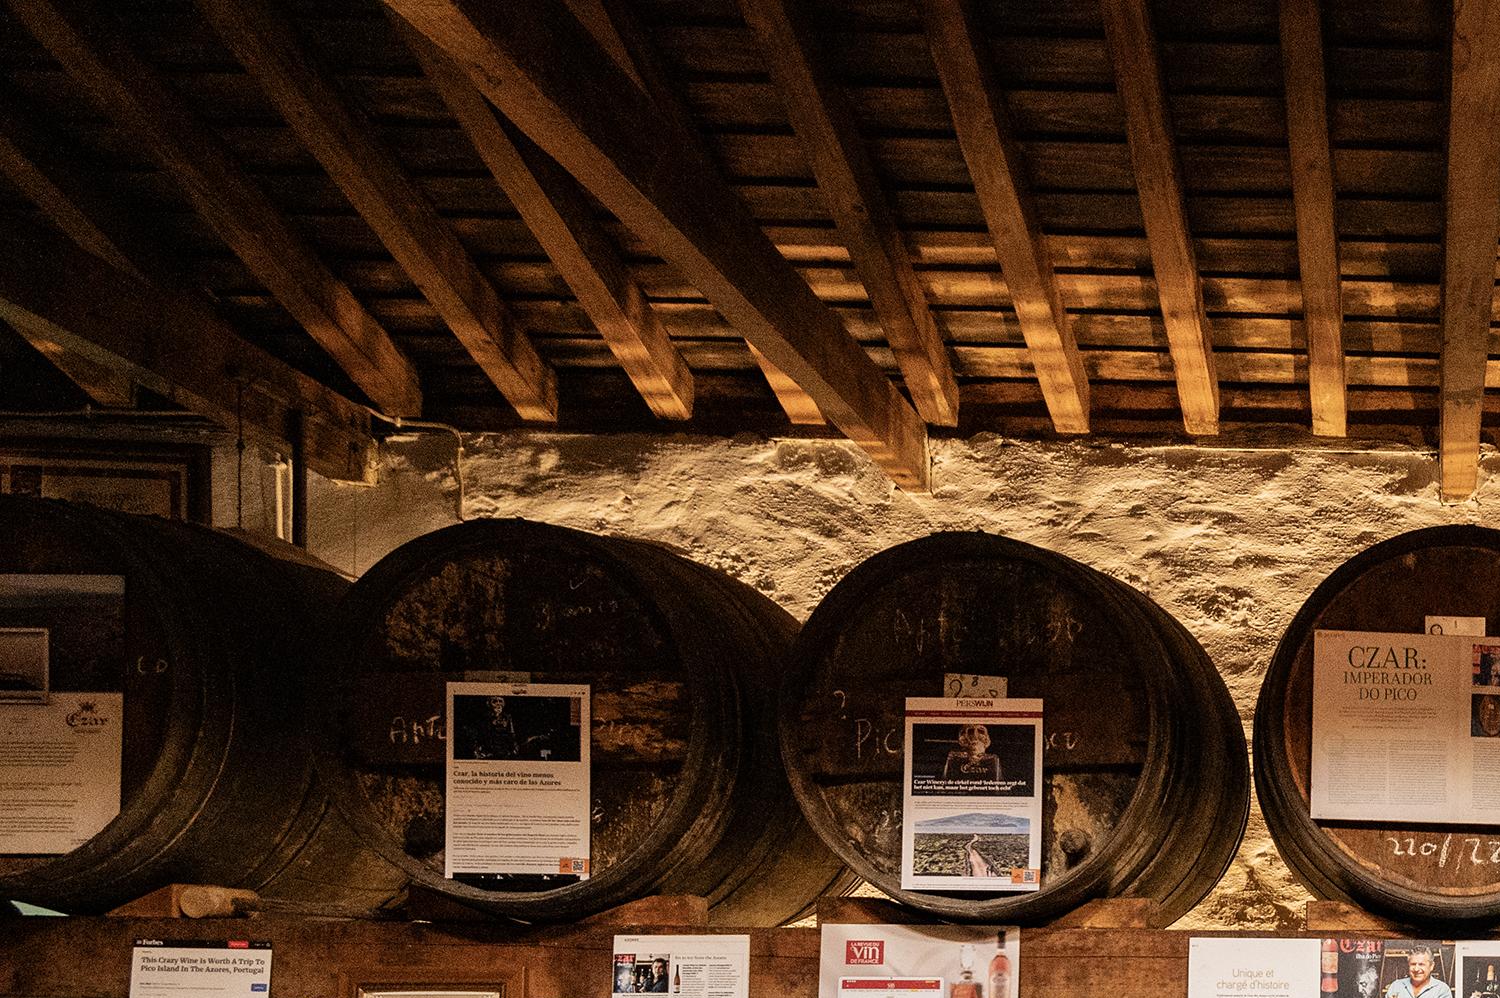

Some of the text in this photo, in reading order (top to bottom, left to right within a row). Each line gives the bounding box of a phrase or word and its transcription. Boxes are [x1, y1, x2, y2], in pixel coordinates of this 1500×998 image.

[1348, 646, 1427, 670] CZAR:
[1343, 672, 1433, 685] IMPERADOR
[1359, 688, 1418, 701] DO PICO
[850, 946, 880, 959] vin
[140, 956, 157, 964] This
[158, 957, 178, 965] Crazy
[239, 958, 254, 967] Trip
[233, 966, 264, 975] Portugal
[1232, 968, 1264, 980] Unique
[1216, 980, 1248, 991] chargé
